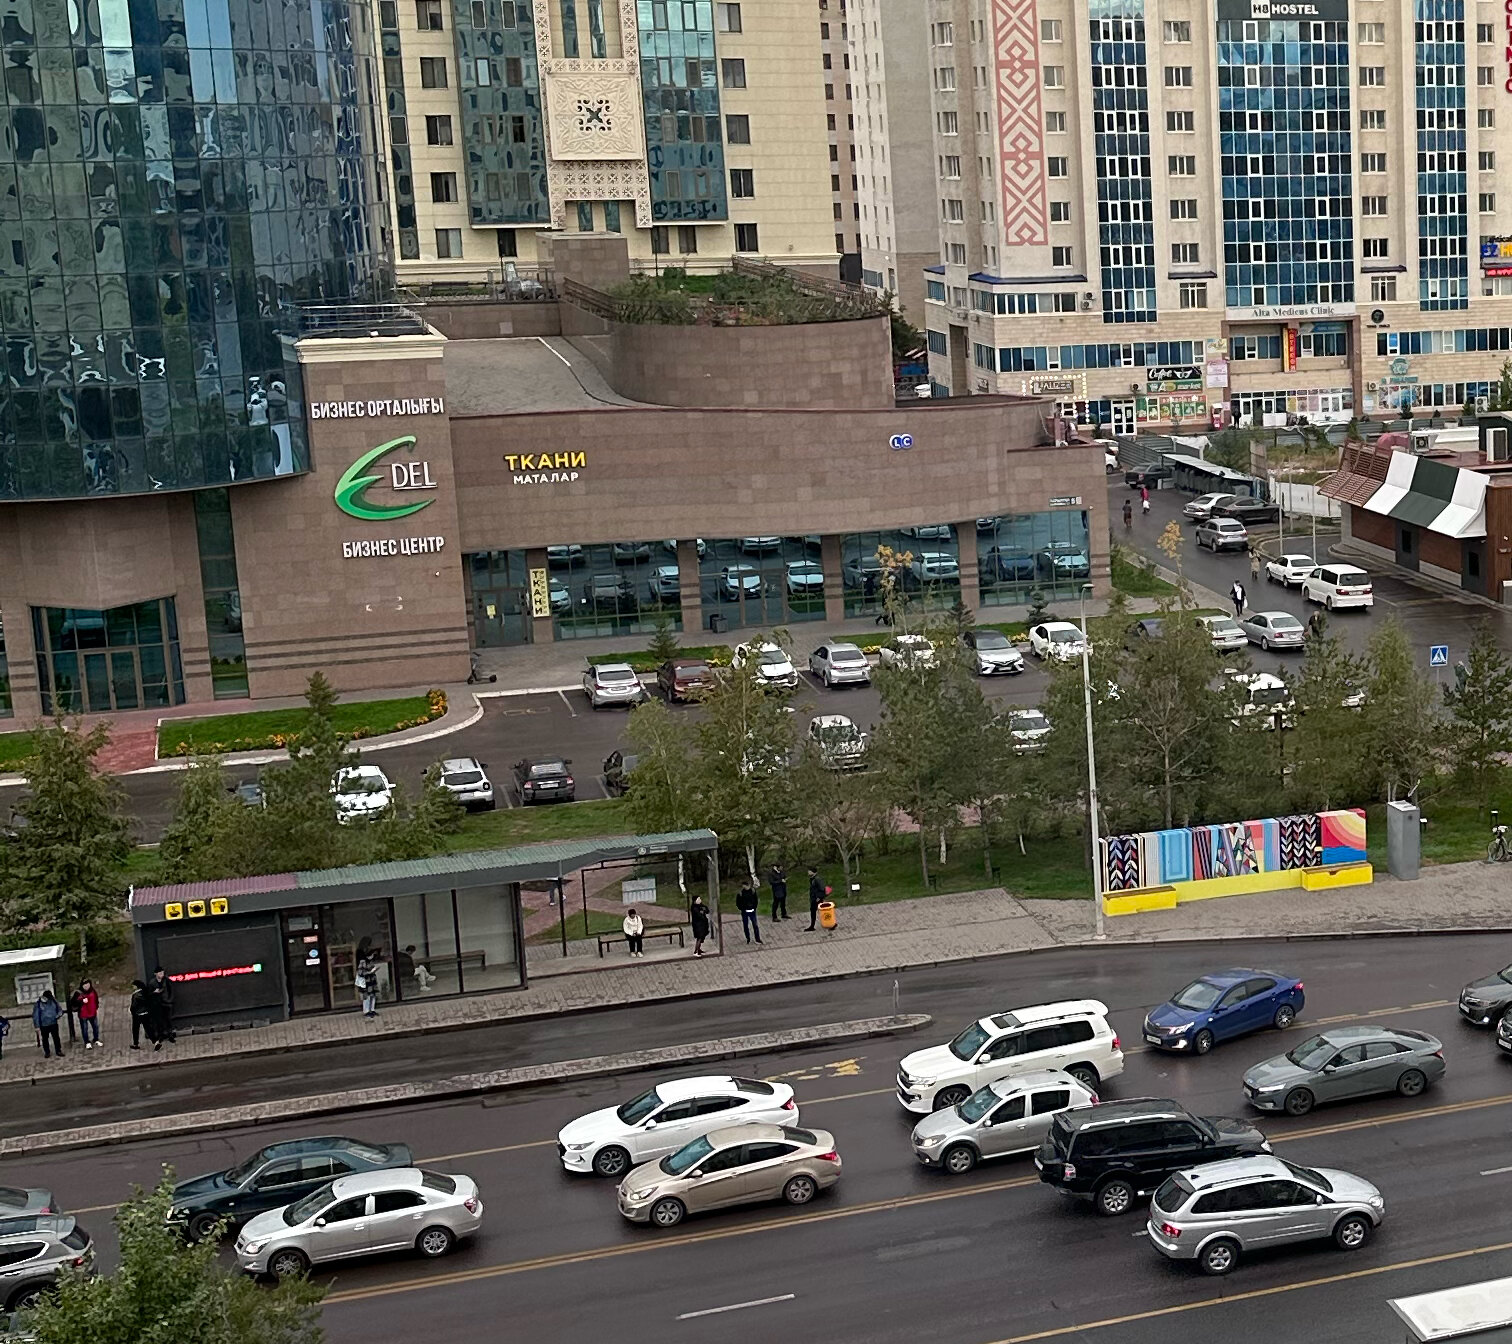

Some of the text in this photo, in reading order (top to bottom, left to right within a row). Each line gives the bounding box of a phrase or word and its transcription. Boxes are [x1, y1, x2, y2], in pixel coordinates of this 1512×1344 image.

[1271, 3, 1319, 15] HOSTEL
[1252, 305, 1335, 317] Alta Medicus Clinic
[310, 397, 445, 420] БИЗНЕС ОРТАЛЫҒЫ
[504, 451, 588, 471] ТКАНИ
[513, 472, 580, 486] МАТАЛАР
[342, 536, 446, 559] БИЗНЕС ЦЕНТР
[532, 570, 542, 615] ТКАНИ
